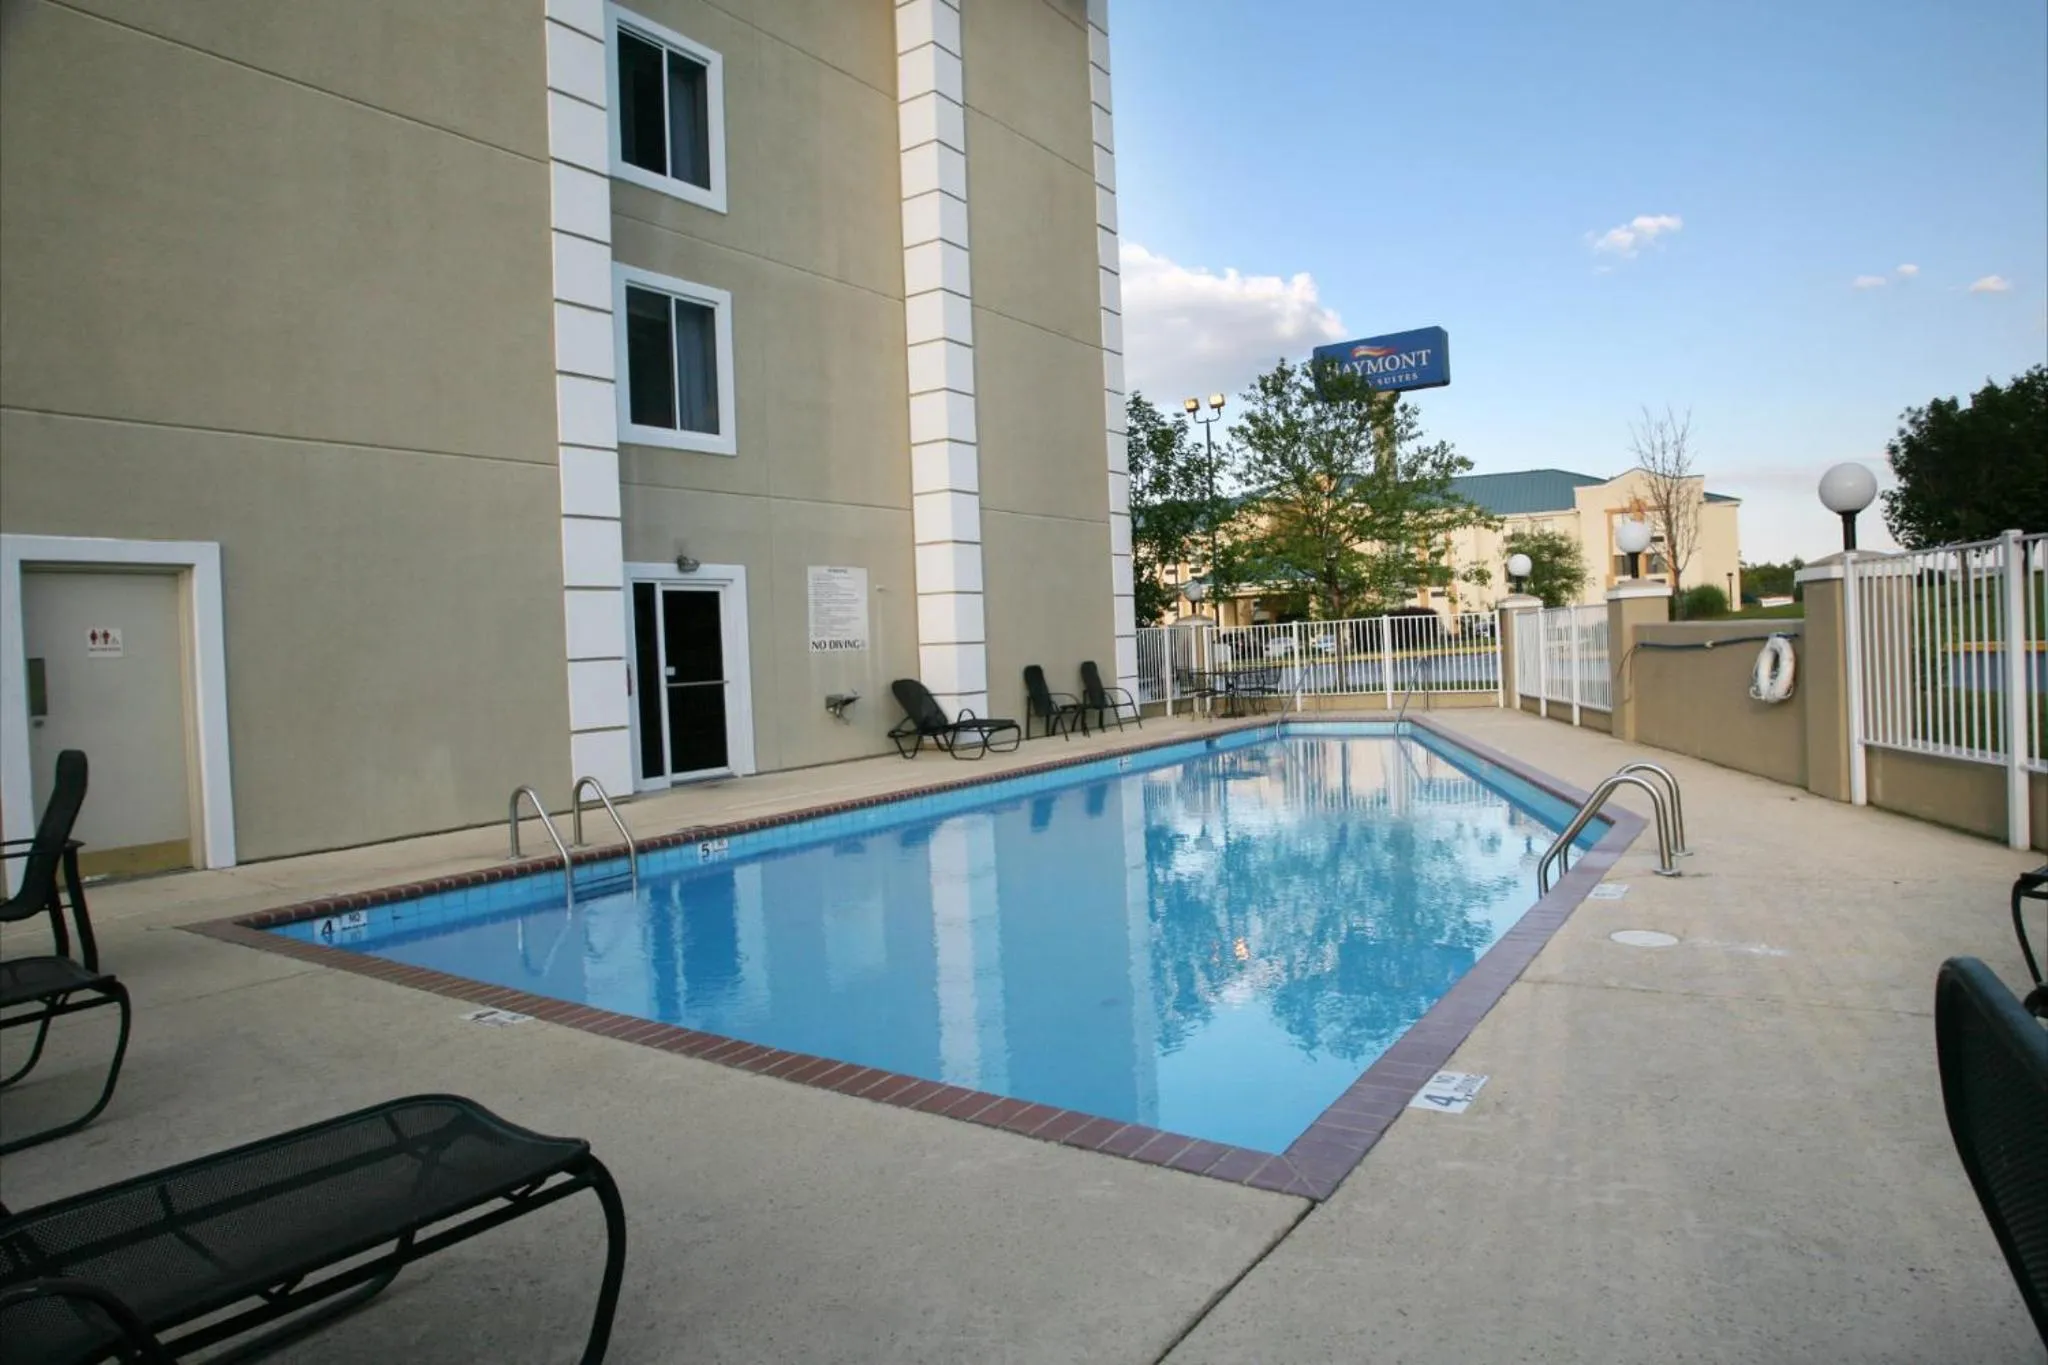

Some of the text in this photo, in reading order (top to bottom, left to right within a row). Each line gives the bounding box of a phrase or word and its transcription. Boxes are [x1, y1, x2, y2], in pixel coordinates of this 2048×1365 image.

[1377, 371, 1418, 386] SUITES
[811, 639, 860, 649] NO DIVING
[701, 843, 710, 858] 5
[320, 919, 335, 938] 4
[1423, 1094, 1466, 1107] 4
